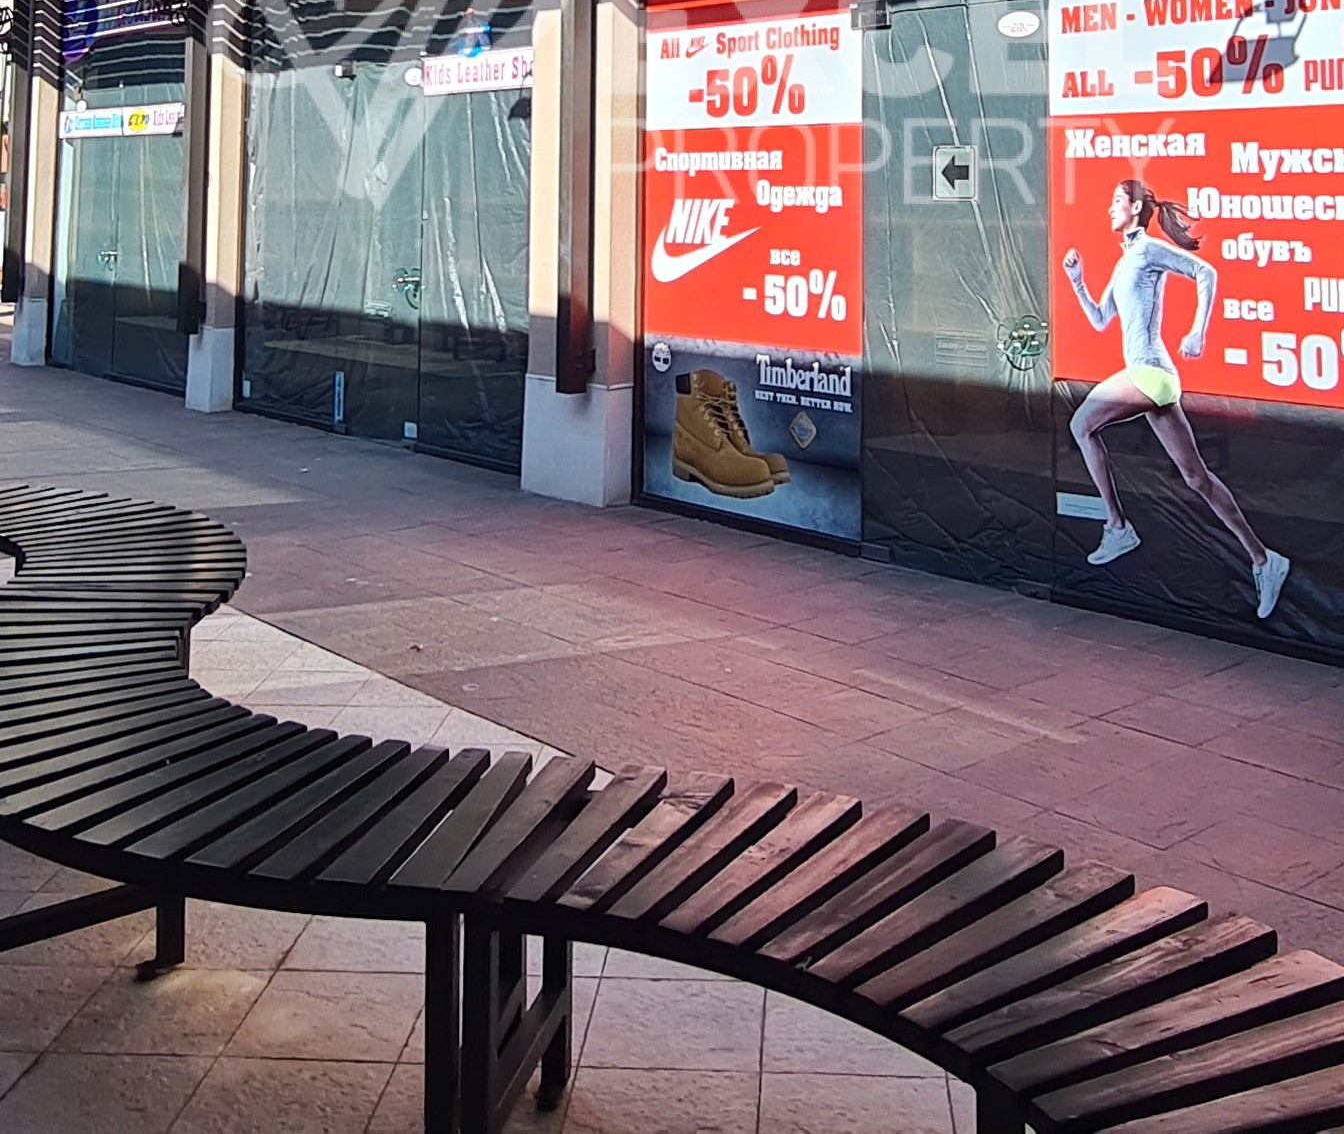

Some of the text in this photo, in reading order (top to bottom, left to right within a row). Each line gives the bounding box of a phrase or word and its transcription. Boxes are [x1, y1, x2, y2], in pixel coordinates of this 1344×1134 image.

[1060, 1, 1118, 35] MEN
[660, 37, 681, 60] All
[716, 31, 760, 59] Sport
[765, 23, 841, 51] Clothing
[424, 62, 452, 87] Kids
[456, 58, 506, 84] Leather
[1061, 69, 1115, 99] ALL
[1134, 34, 1286, 100] -50%
[688, 54, 806, 118] -50%
[1064, 128, 1206, 159] Женская
[655, 147, 783, 177] Спортивная
[756, 179, 843, 213] Одежда
[665, 198, 735, 245] NIKE
[769, 249, 801, 266] все
[1222, 298, 1275, 322] все
[755, 353, 852, 397] Timberland
[754, 389, 775, 402] BEST
[799, 396, 832, 410] BETTER
